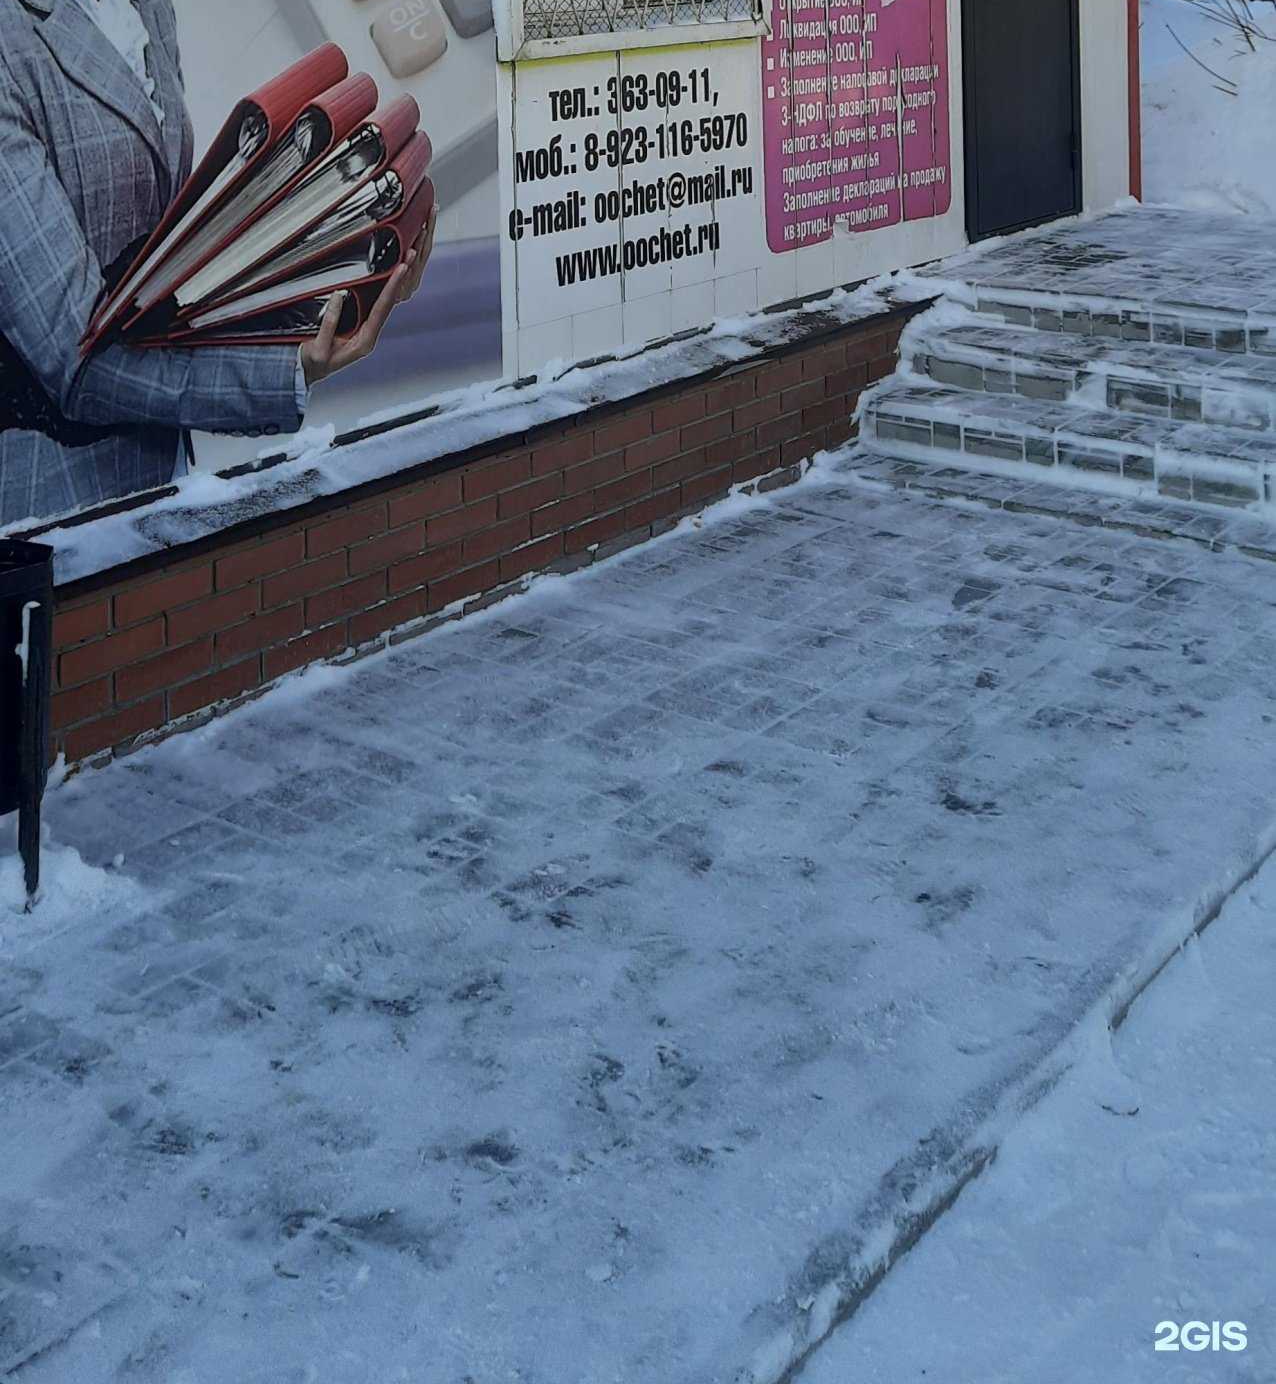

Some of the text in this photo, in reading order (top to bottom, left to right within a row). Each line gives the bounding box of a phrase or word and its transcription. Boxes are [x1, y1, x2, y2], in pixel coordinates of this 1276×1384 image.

[548, 67, 719, 122] тел.: 363-09-11,
[515, 112, 748, 184] моб.: 8-923-116-5970
[910, 165, 947, 190] продажу
[508, 165, 753, 242] e-mail: oochet@mail.ru
[555, 221, 720, 287] www.oochet.ru
